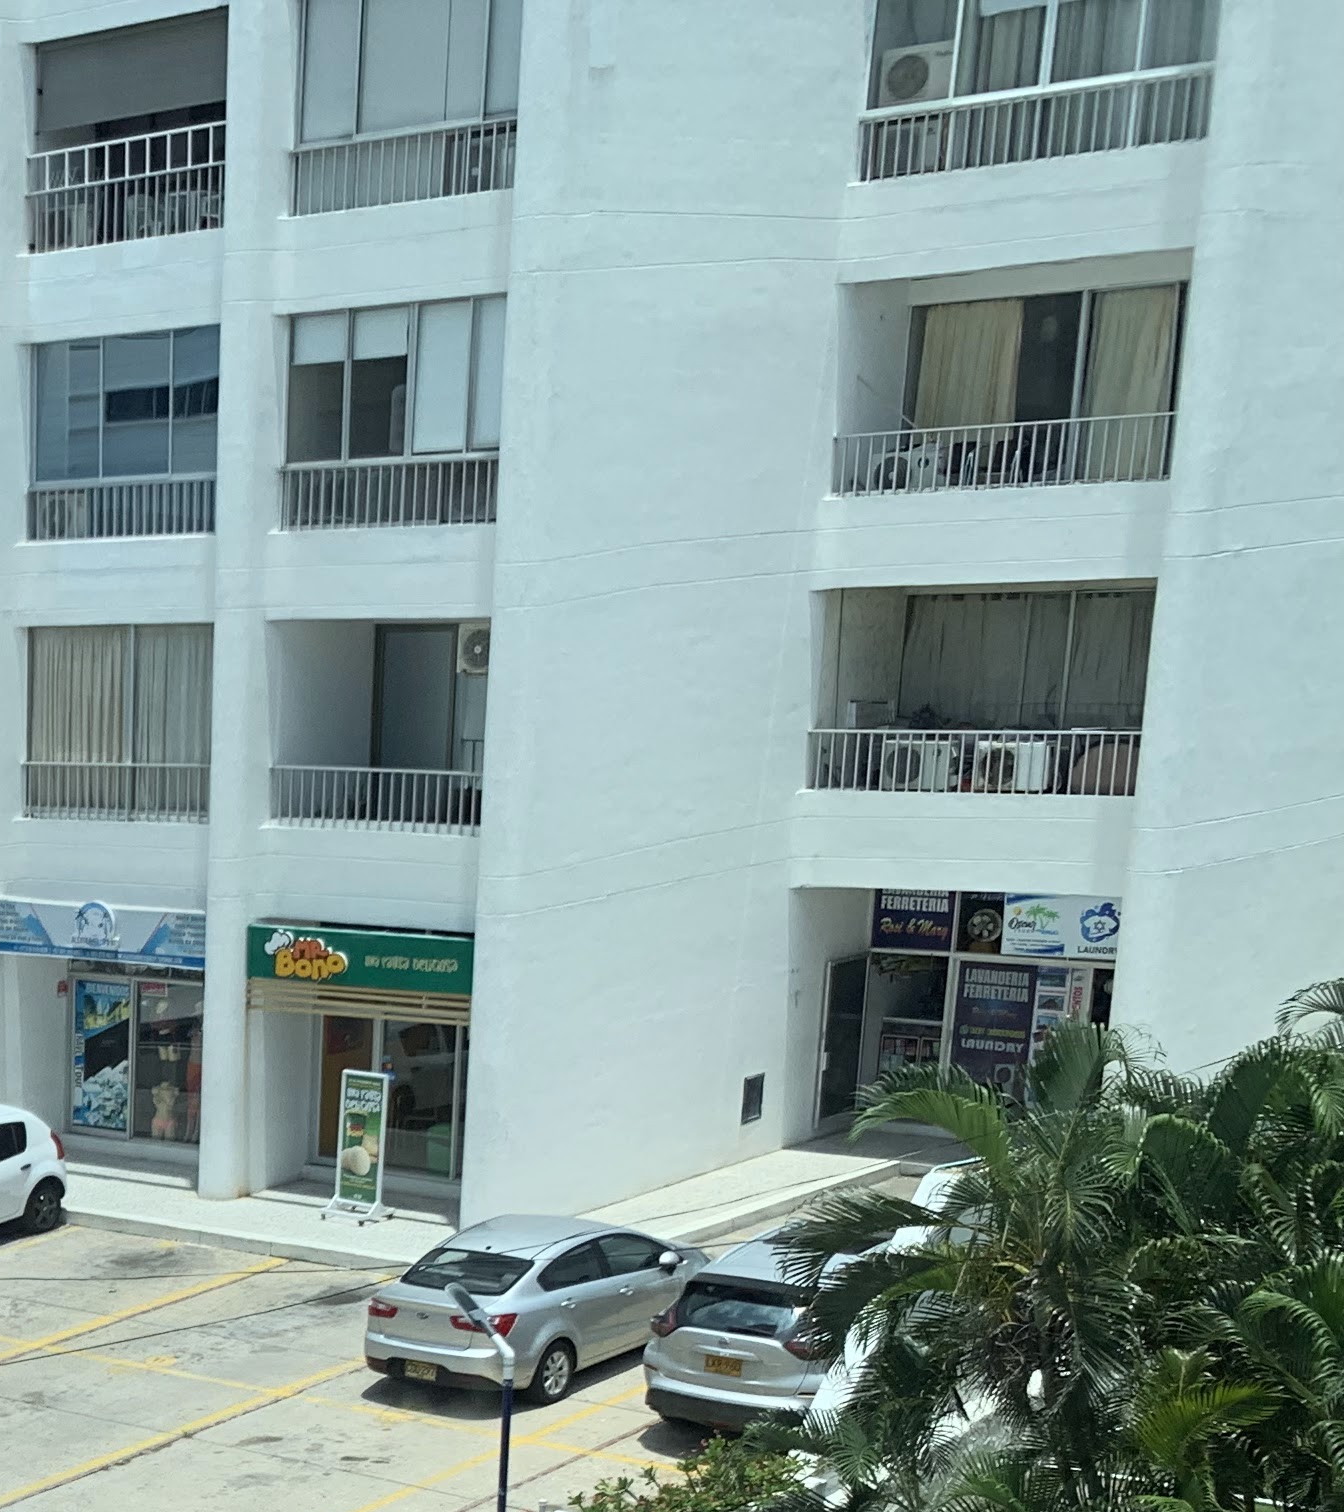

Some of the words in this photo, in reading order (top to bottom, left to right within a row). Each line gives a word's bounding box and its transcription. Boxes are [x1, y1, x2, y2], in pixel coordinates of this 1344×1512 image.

[880, 895, 949, 913] FERRETERIA
[275, 947, 346, 980] Bono
[964, 967, 1029, 987] LAVANDERIA
[963, 984, 1029, 1002] FERRETERIA
[961, 1038, 1024, 1053] LAUNDRY
